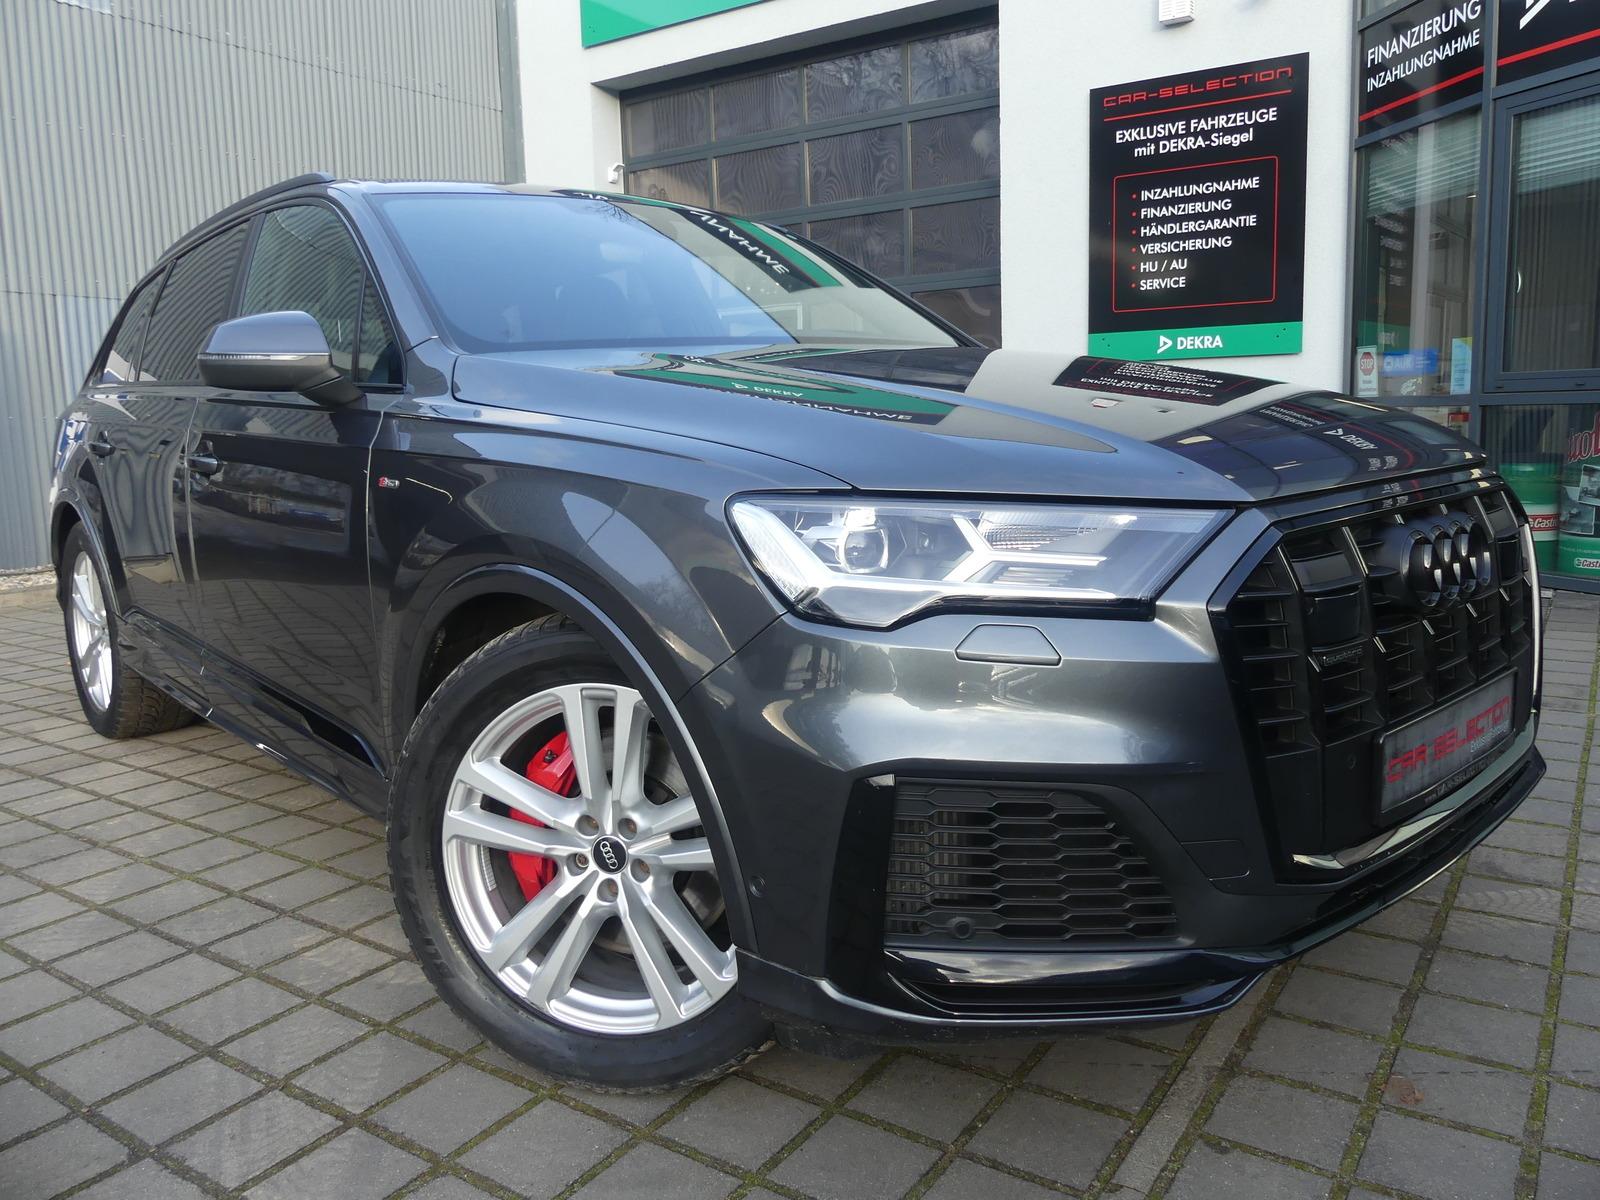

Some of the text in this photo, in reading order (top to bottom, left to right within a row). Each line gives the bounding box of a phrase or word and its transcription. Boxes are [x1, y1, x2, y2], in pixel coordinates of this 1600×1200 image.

[1367, 0, 1482, 68] FINANZIERUNG
[1367, 29, 1480, 93] INZAHLUNGNAHME
[1103, 67, 1292, 108] CAR-SELECTION
[1115, 107, 1278, 144] EXKLUSIVE FAHRZEUGE
[1134, 127, 1254, 158] mit DEKRA-Siegel
[1141, 176, 1260, 202] INZAHLUNGNAHME
[1140, 199, 1232, 220] FINANZIERUNG
[1140, 214, 1257, 237] HÄNDLERGARANTIE
[1140, 235, 1233, 255] VERSICHERUNG
[1140, 258, 1188, 273] HU / AU
[1140, 276, 1186, 291] SERVICE
[1176, 335, 1223, 350] DEKRA
[1360, 359, 1374, 370] STOP
